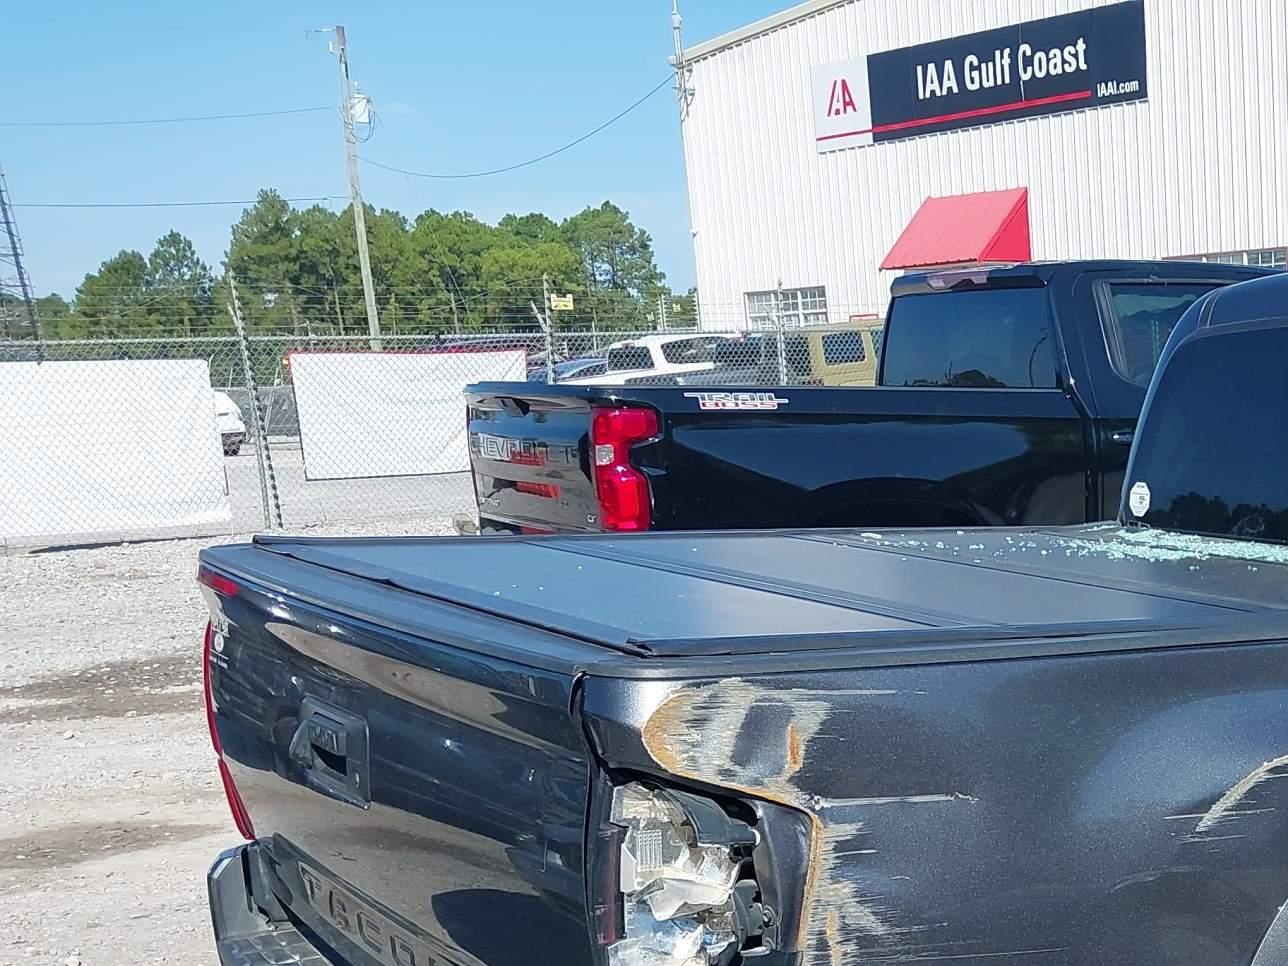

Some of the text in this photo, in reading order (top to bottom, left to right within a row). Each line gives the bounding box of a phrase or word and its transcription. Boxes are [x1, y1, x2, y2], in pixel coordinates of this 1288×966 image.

[917, 37, 1088, 101] IAA Gulf Coast
[1096, 78, 1139, 99] IAAI.com
